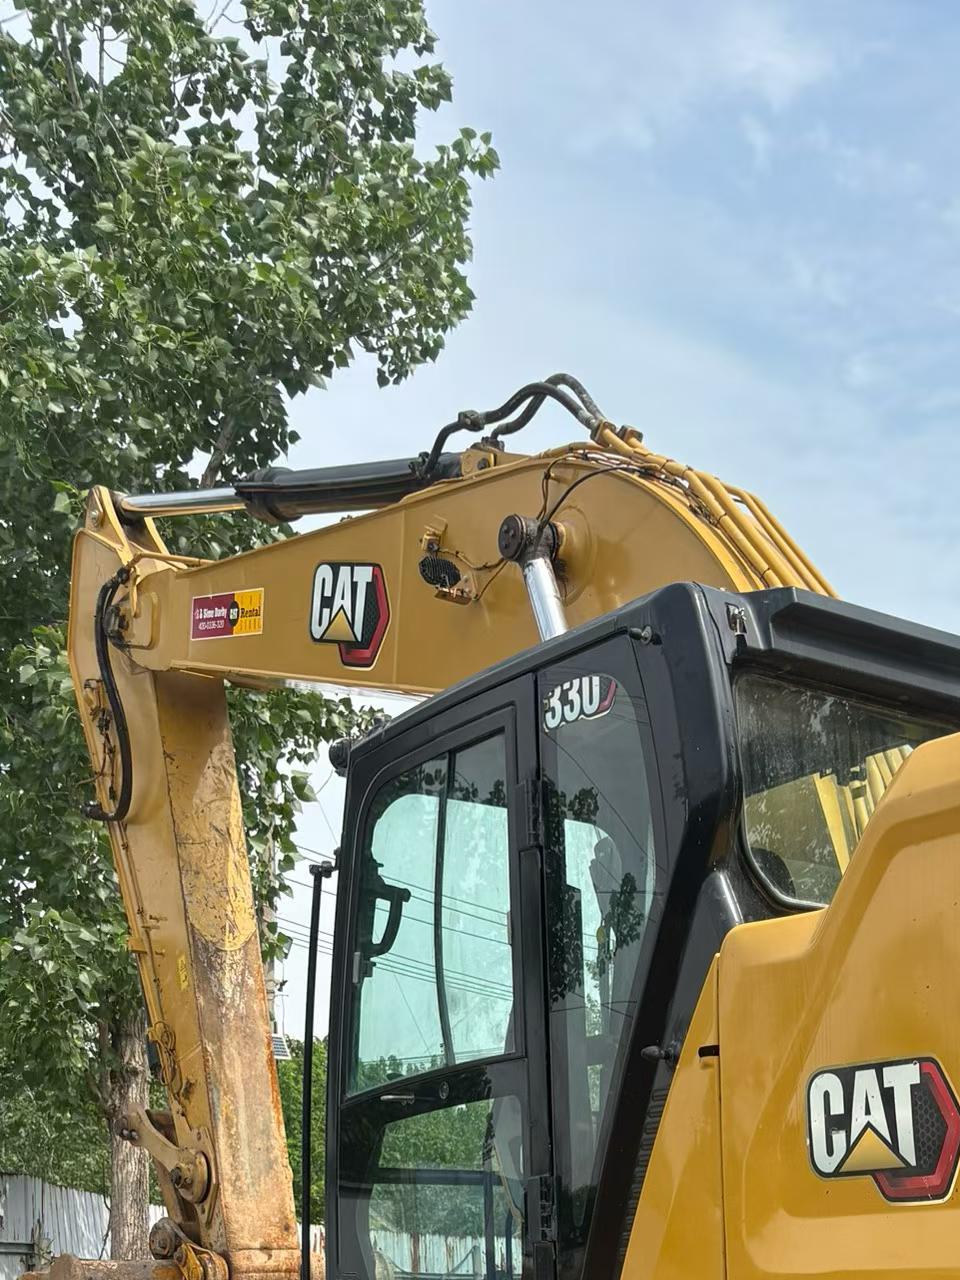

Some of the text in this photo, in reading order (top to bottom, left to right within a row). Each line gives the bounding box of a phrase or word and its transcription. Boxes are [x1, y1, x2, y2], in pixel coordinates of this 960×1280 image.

[240, 606, 261, 618] Rental
[311, 564, 373, 642] CAT
[545, 676, 600, 728] 330
[809, 1062, 921, 1174] CAT
